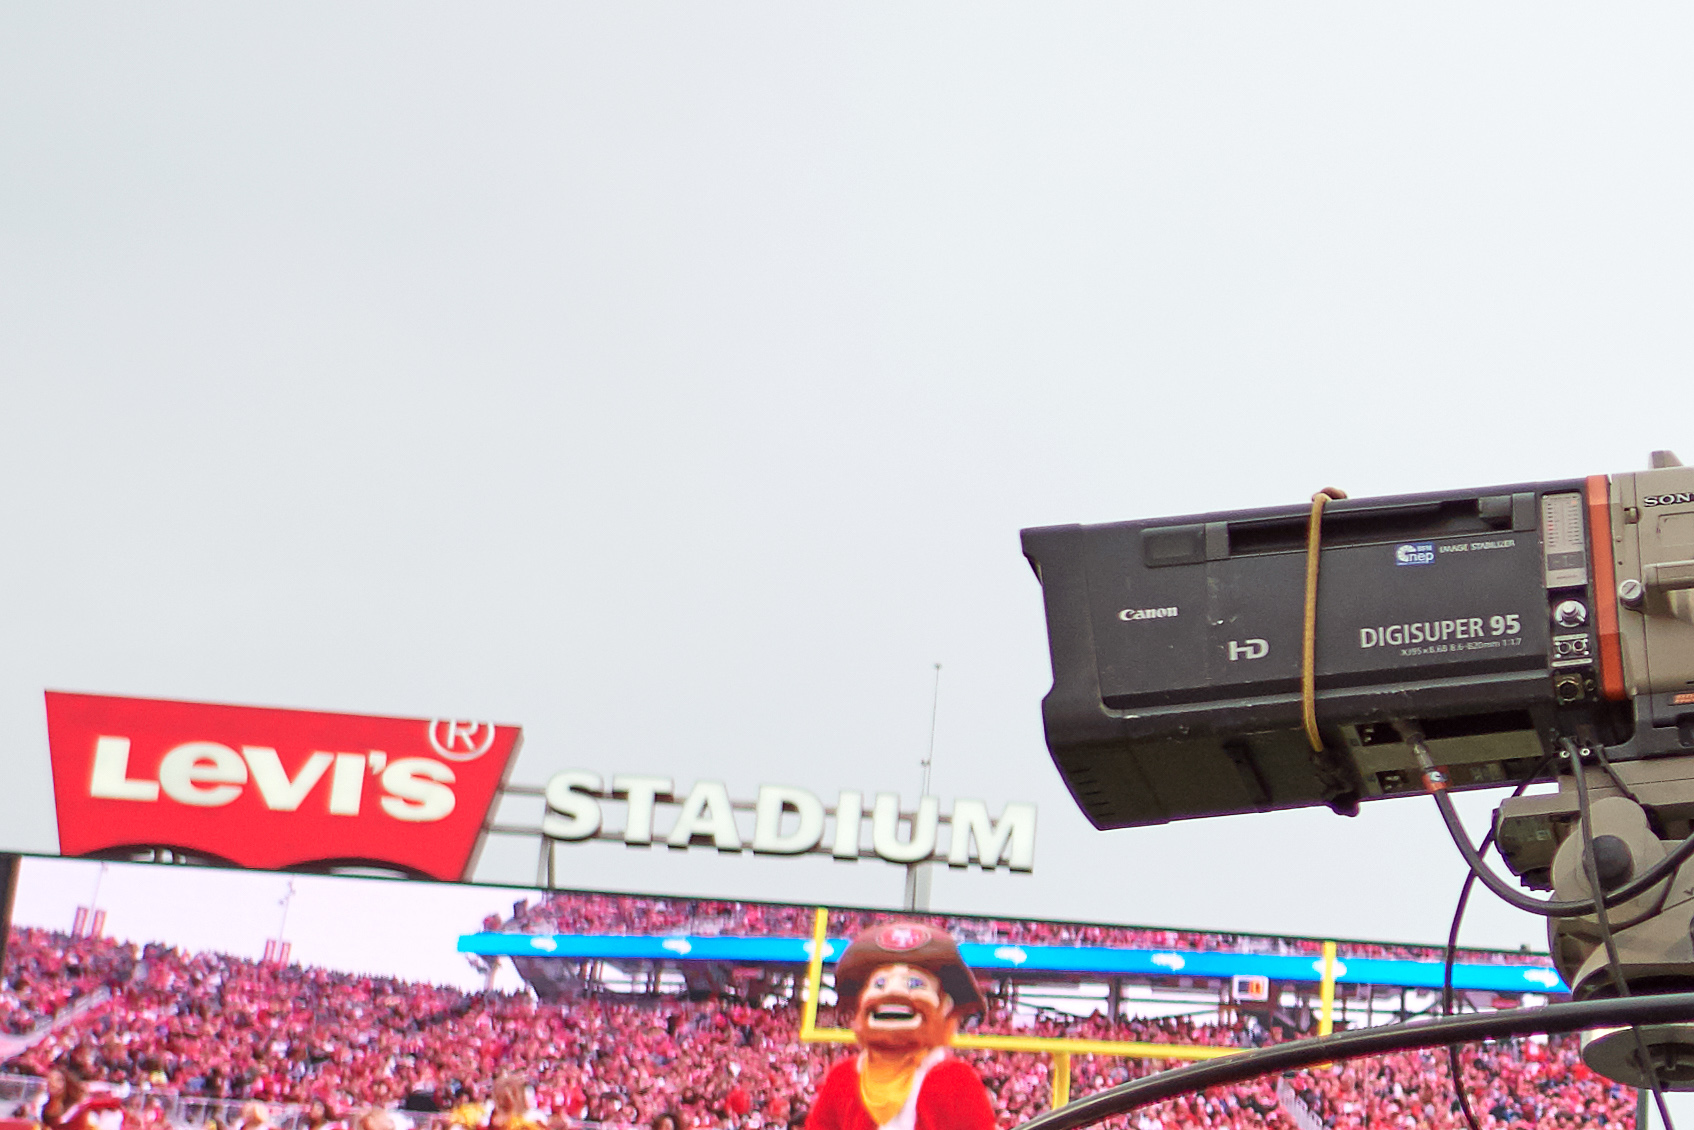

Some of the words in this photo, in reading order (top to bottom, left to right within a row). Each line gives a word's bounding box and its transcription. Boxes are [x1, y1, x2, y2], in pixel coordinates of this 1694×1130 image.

[1118, 606, 1179, 622] Canon
[1360, 617, 1485, 649] DIGISUPER
[1489, 614, 1522, 636] 95
[1228, 638, 1270, 661] HD
[541, 769, 1039, 874] STADIUM
